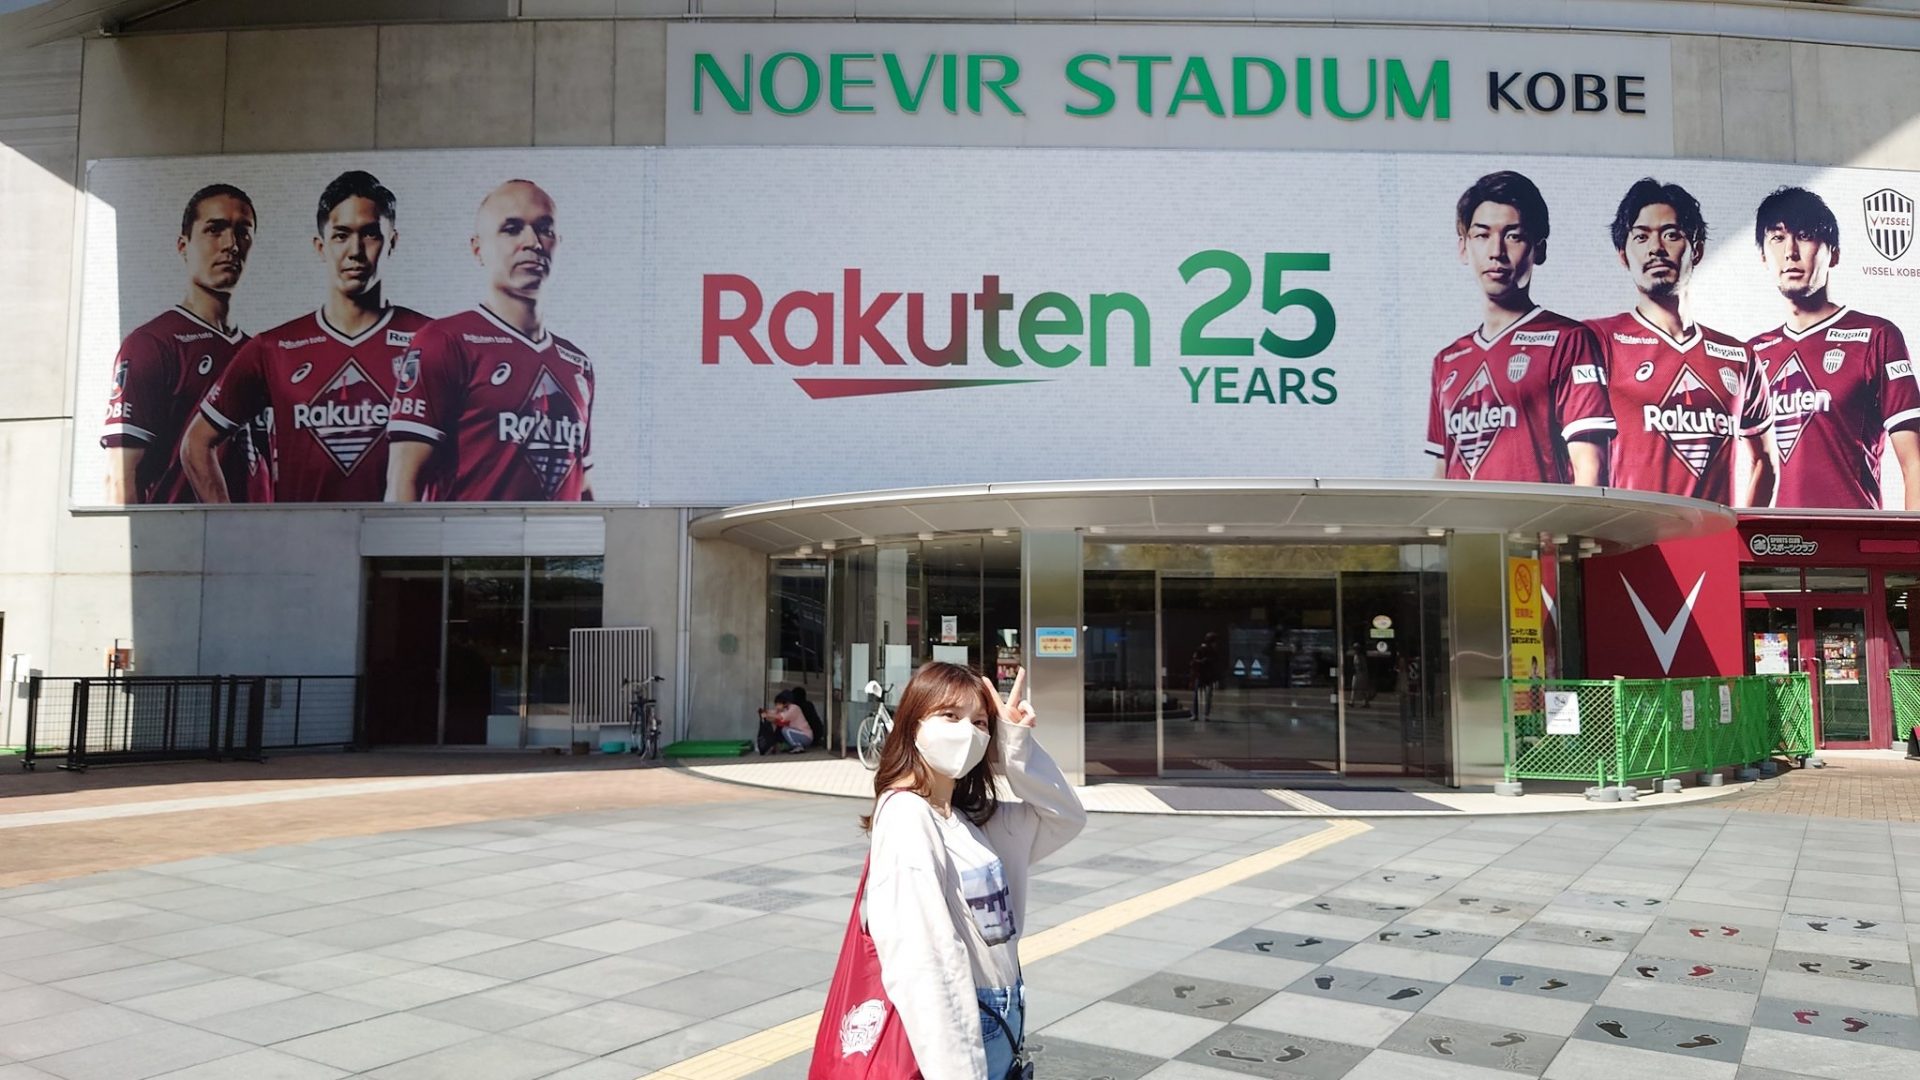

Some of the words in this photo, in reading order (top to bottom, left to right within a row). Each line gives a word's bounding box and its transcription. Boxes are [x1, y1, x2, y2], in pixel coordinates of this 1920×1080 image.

[693, 51, 1023, 116] NOEVIR
[1065, 54, 1451, 122] STADIUM
[1487, 69, 1647, 116] KOBE
[1880, 216, 1910, 226] VISSEL
[1862, 266, 1895, 276] VISSEL
[1178, 249, 1338, 357] 25
[702, 267, 1151, 367] Rakuten
[1514, 332, 1556, 344] Regain
[1828, 328, 1869, 340] Regain
[1706, 342, 1745, 358] Regain
[1181, 366, 1338, 404] YEARS
[1770, 543, 1816, 552] スポーツクラブ
